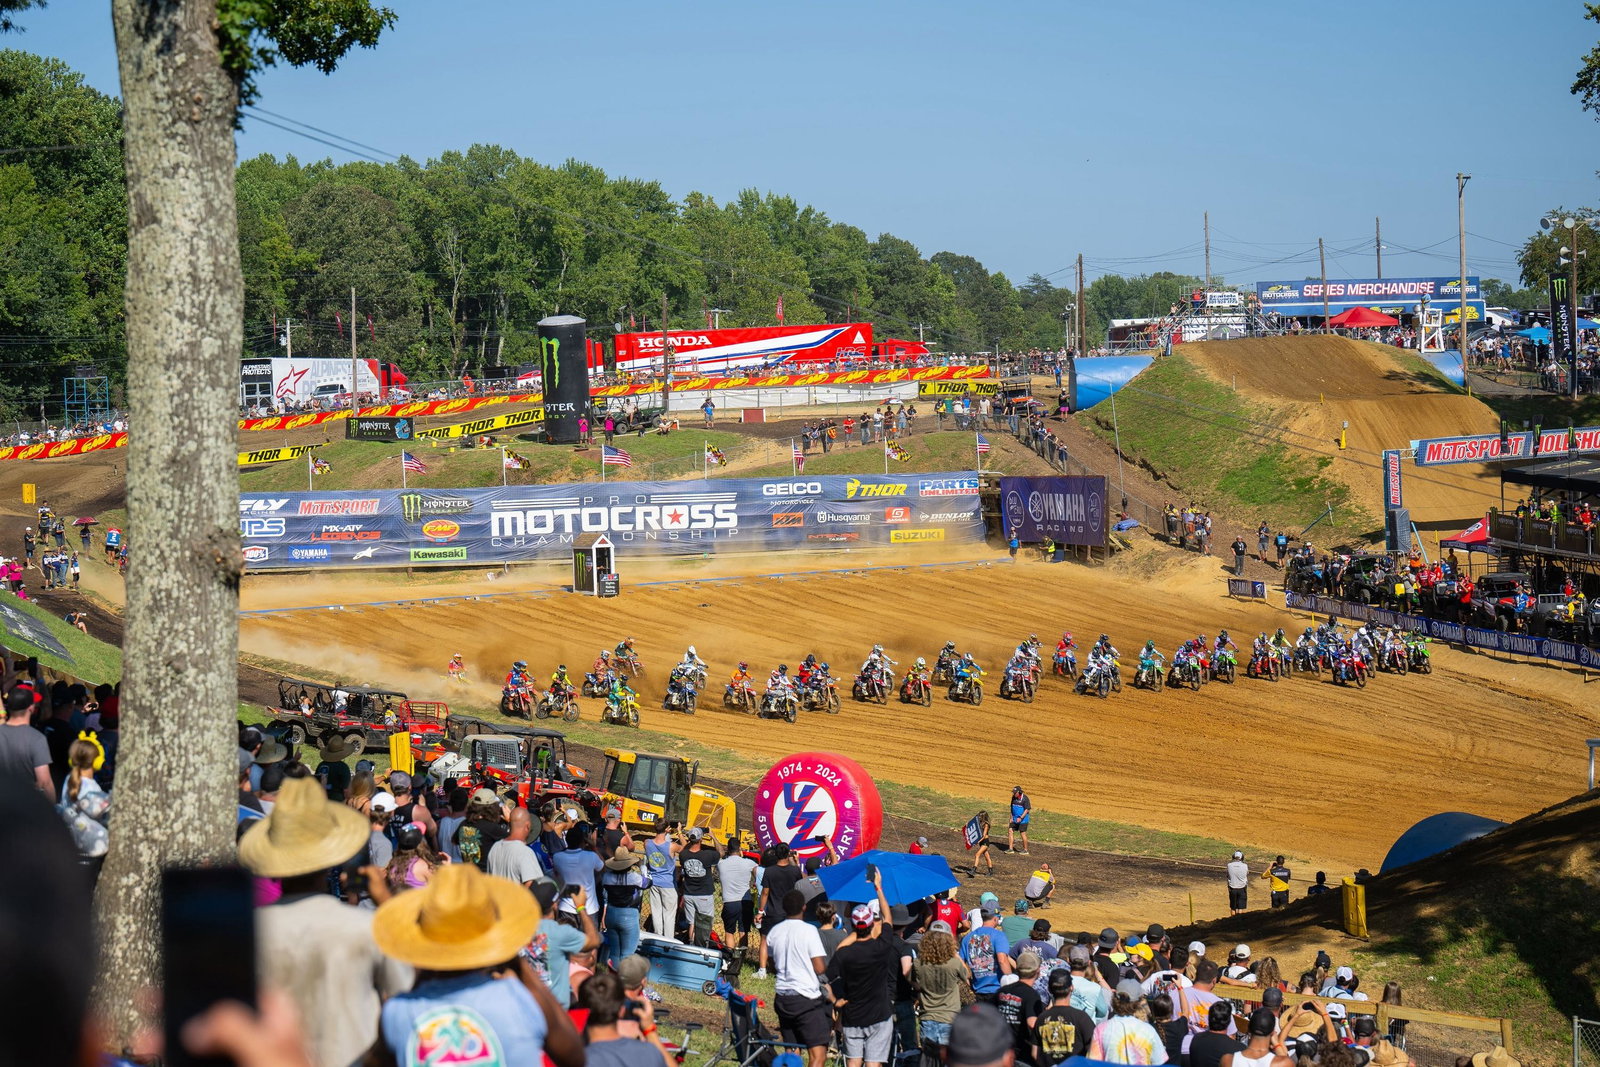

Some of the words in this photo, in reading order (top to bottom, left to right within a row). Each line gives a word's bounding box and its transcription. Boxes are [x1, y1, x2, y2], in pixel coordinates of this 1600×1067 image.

[1347, 282, 1435, 295] MERCHANDISE
[638, 335, 712, 348] HONDA
[833, 370, 869, 383] FMF
[913, 366, 949, 380] FMF
[953, 364, 988, 379] FMF
[675, 378, 710, 391] FMF
[714, 377, 749, 389] FMF
[793, 373, 829, 386] FMF
[937, 383, 968, 393] THOR
[396, 402, 429, 417] FMF
[434, 399, 470, 414] FMF
[286, 413, 317, 429] FMF
[505, 409, 541, 425] THOR
[359, 421, 391, 431] MONSTER
[460, 418, 495, 435] THOR
[49, 440, 77, 457] FMF
[81, 434, 112, 453] FMF
[248, 449, 281, 462] THOR
[920, 479, 979, 490] PARTS
[1391, 455, 1400, 505] MOTOSPORT
[763, 482, 822, 495] GEICO
[860, 483, 908, 496] THOR
[920, 488, 979, 496] UNLIMITED
[424, 500, 469, 508] MONSTER
[584, 495, 648, 505] PRO
[299, 500, 379, 514] MOTOSPORT
[1042, 493, 1086, 521] YAMAHA
[491, 503, 738, 536] MOTOCROSS
[827, 513, 870, 522] Husqvarna
[931, 511, 975, 520] DUNLOP
[425, 523, 457, 532] FMF
[1036, 524, 1084, 533] RACING
[491, 529, 739, 547] CHAMIONSHIP
[894, 530, 941, 541] SUZUKI
[245, 549, 265, 558] 100%
[300, 549, 328, 557] YAMAHA
[413, 549, 464, 559] Kawasaki
[1473, 630, 1499, 647] YAMAHA
[1510, 636, 1537, 653] YAMAHA
[1551, 641, 1576, 660] YAMAHA
[777, 762, 802, 780] 1974
[815, 764, 842, 787] 2024
[642, 812, 655, 822] CAT
